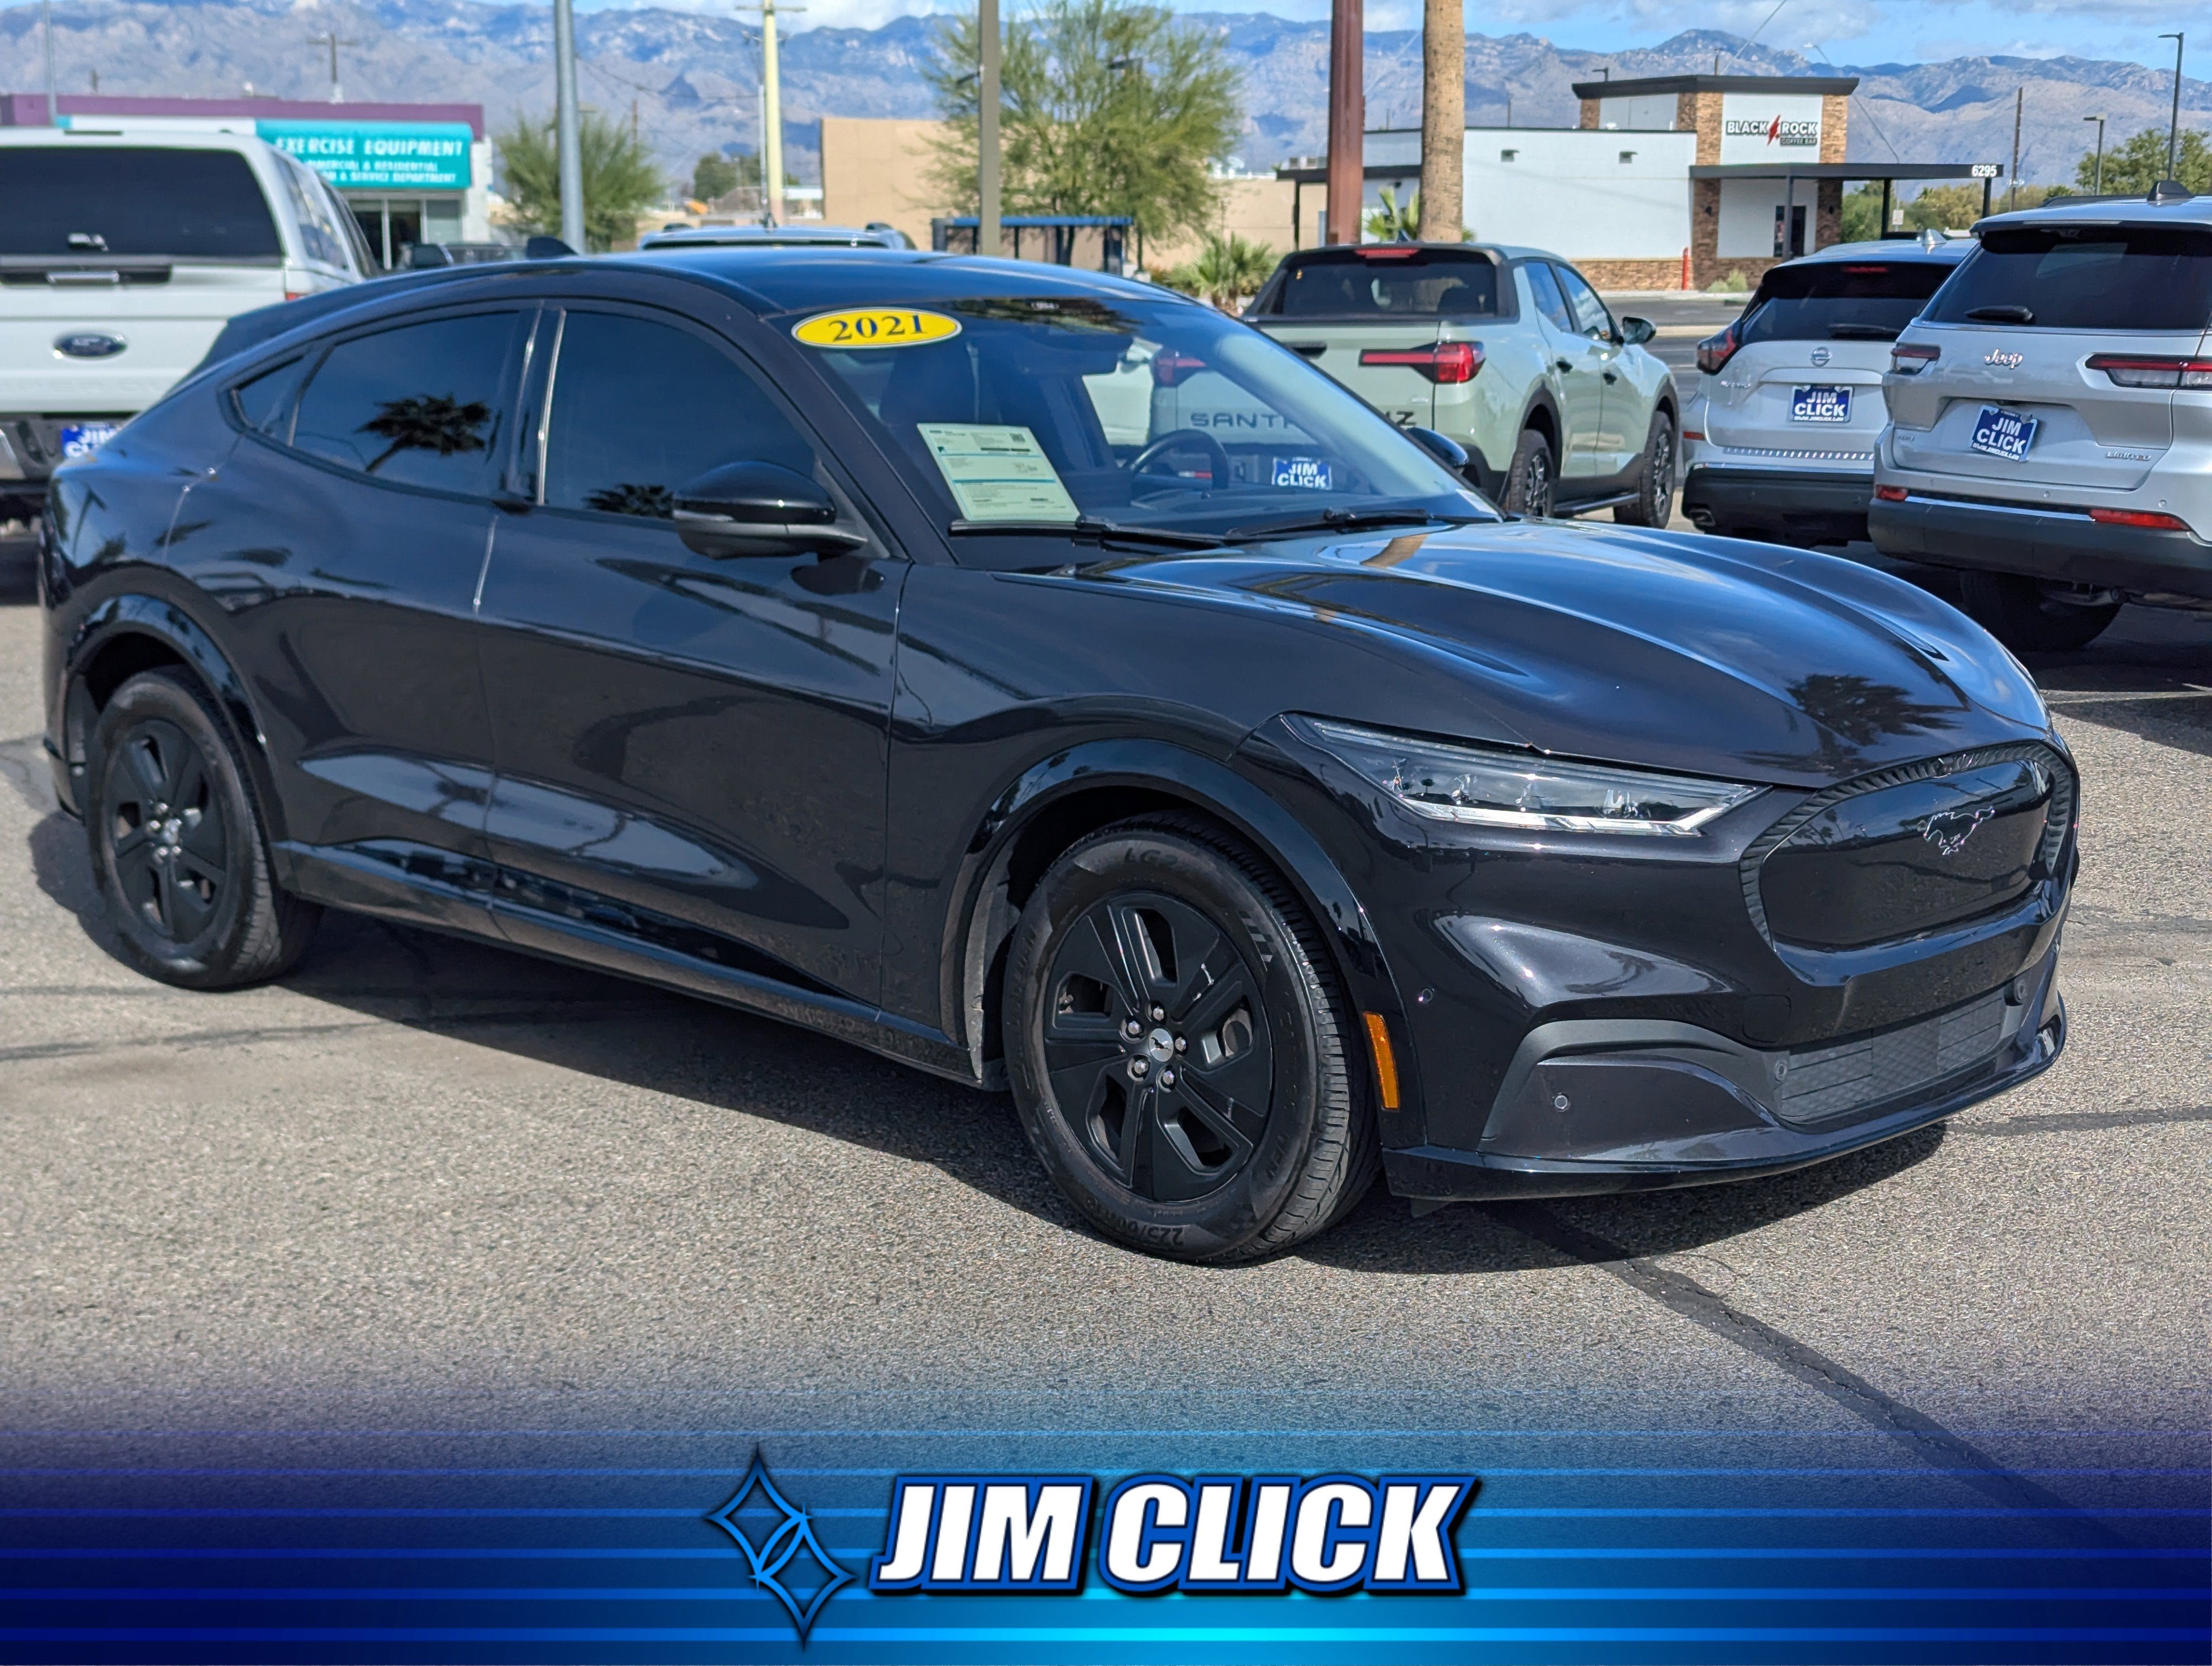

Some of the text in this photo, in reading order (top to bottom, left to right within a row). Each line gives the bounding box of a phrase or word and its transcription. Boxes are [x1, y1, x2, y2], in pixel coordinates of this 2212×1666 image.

[1726, 121, 1817, 135] BLACK ROCK
[275, 138, 462, 156] EXERCISE EQUIPMENT
[1971, 165, 1998, 178] 6295
[828, 313, 928, 343] 2021
[1985, 348, 2023, 370] Jeep
[1806, 391, 1837, 404] JIM
[1795, 402, 1846, 417] CLICK
[1991, 417, 2022, 437] JIM
[1976, 428, 2027, 454] CLICK
[1288, 462, 1318, 476] JIM
[1277, 472, 1327, 488] CLICK
